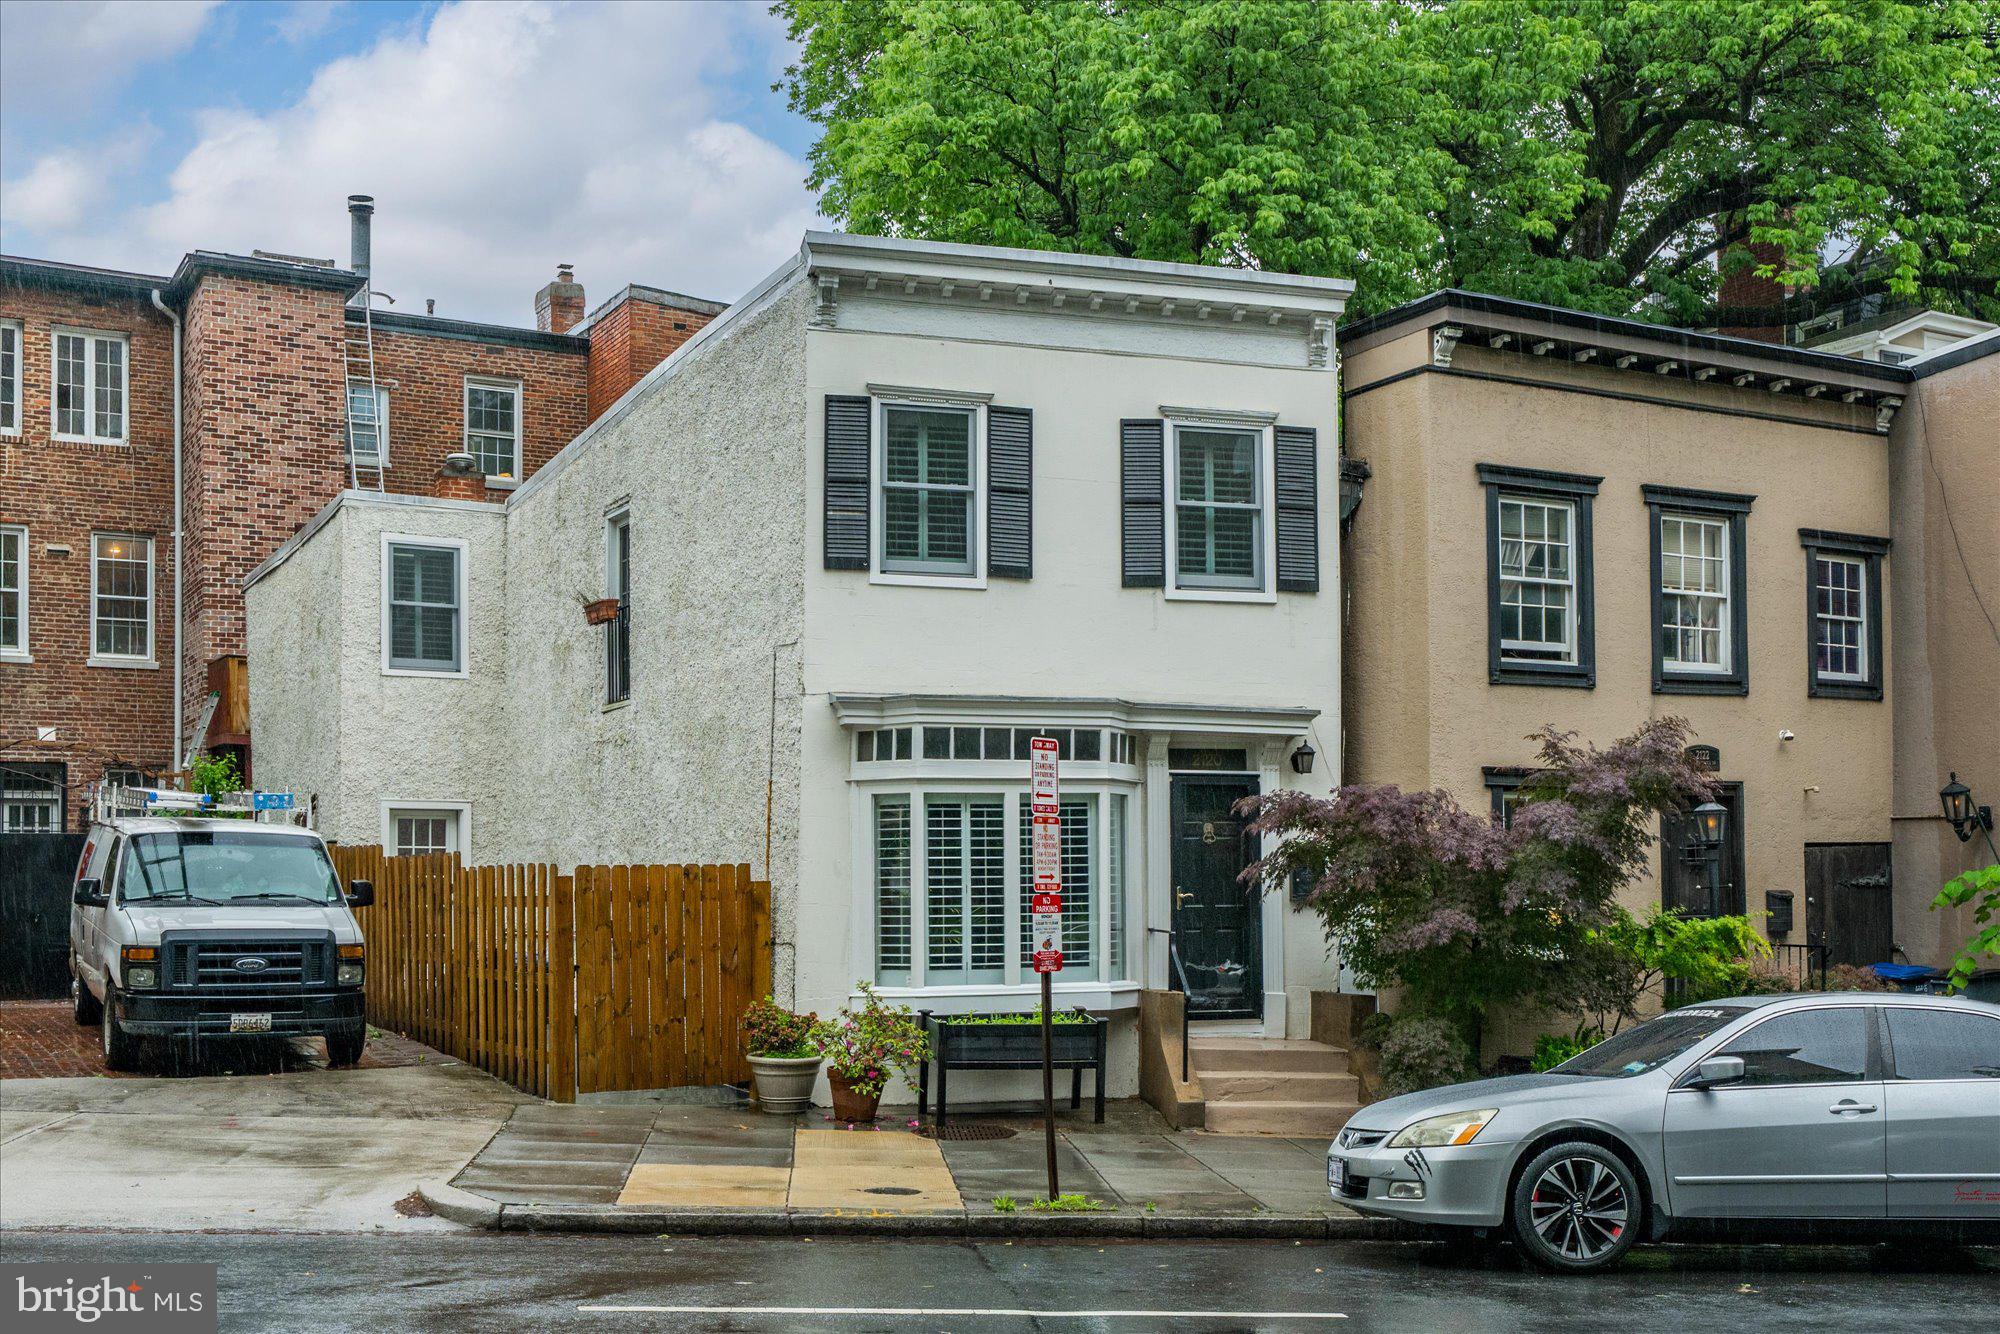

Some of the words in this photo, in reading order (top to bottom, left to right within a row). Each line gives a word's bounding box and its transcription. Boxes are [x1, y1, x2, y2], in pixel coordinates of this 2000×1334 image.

[1041, 753, 1049, 761] NO
[1696, 750, 1710, 760] 2122
[1035, 762, 1055, 771] STANDING
[1037, 780, 1053, 788] ANYTIME
[1037, 833, 1056, 841] STANDING
[1041, 842, 1058, 850] PARKING
[1042, 896, 1051, 905] NO
[1035, 905, 1059, 913] PARKING
